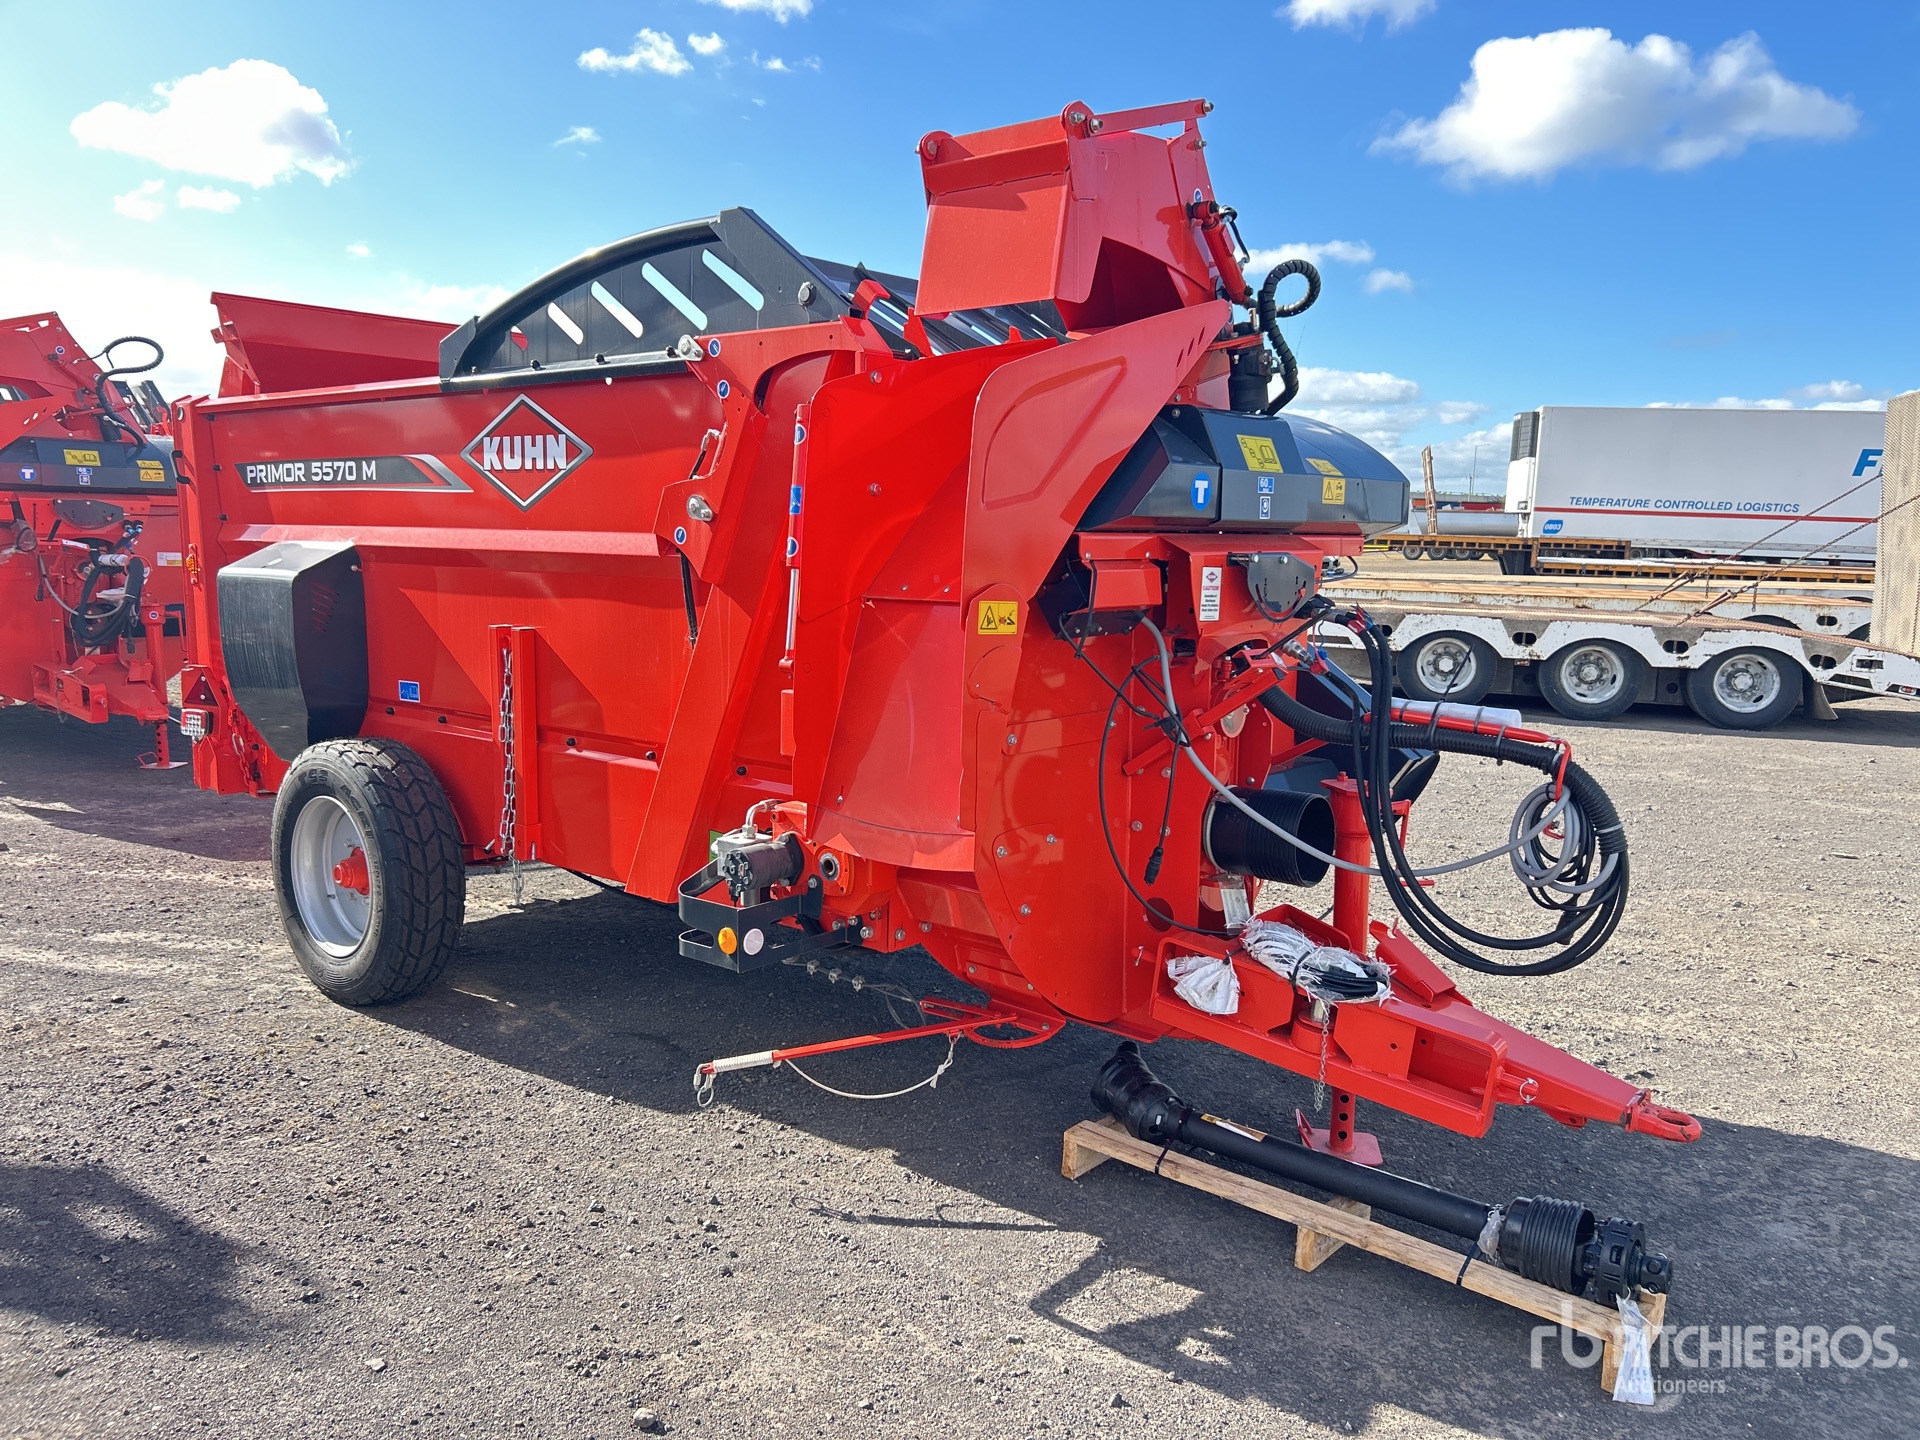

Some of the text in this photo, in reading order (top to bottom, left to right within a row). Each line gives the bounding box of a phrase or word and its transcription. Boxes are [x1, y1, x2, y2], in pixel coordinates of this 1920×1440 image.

[483, 434, 567, 470] KUHN
[1852, 449, 1884, 476] F
[22, 469, 33, 479] T
[247, 460, 376, 483] PRIMOR 5570 M
[1195, 480, 1208, 503] T
[1569, 496, 1800, 513] TEMPERATURE CONTROLLED LOGISTICS
